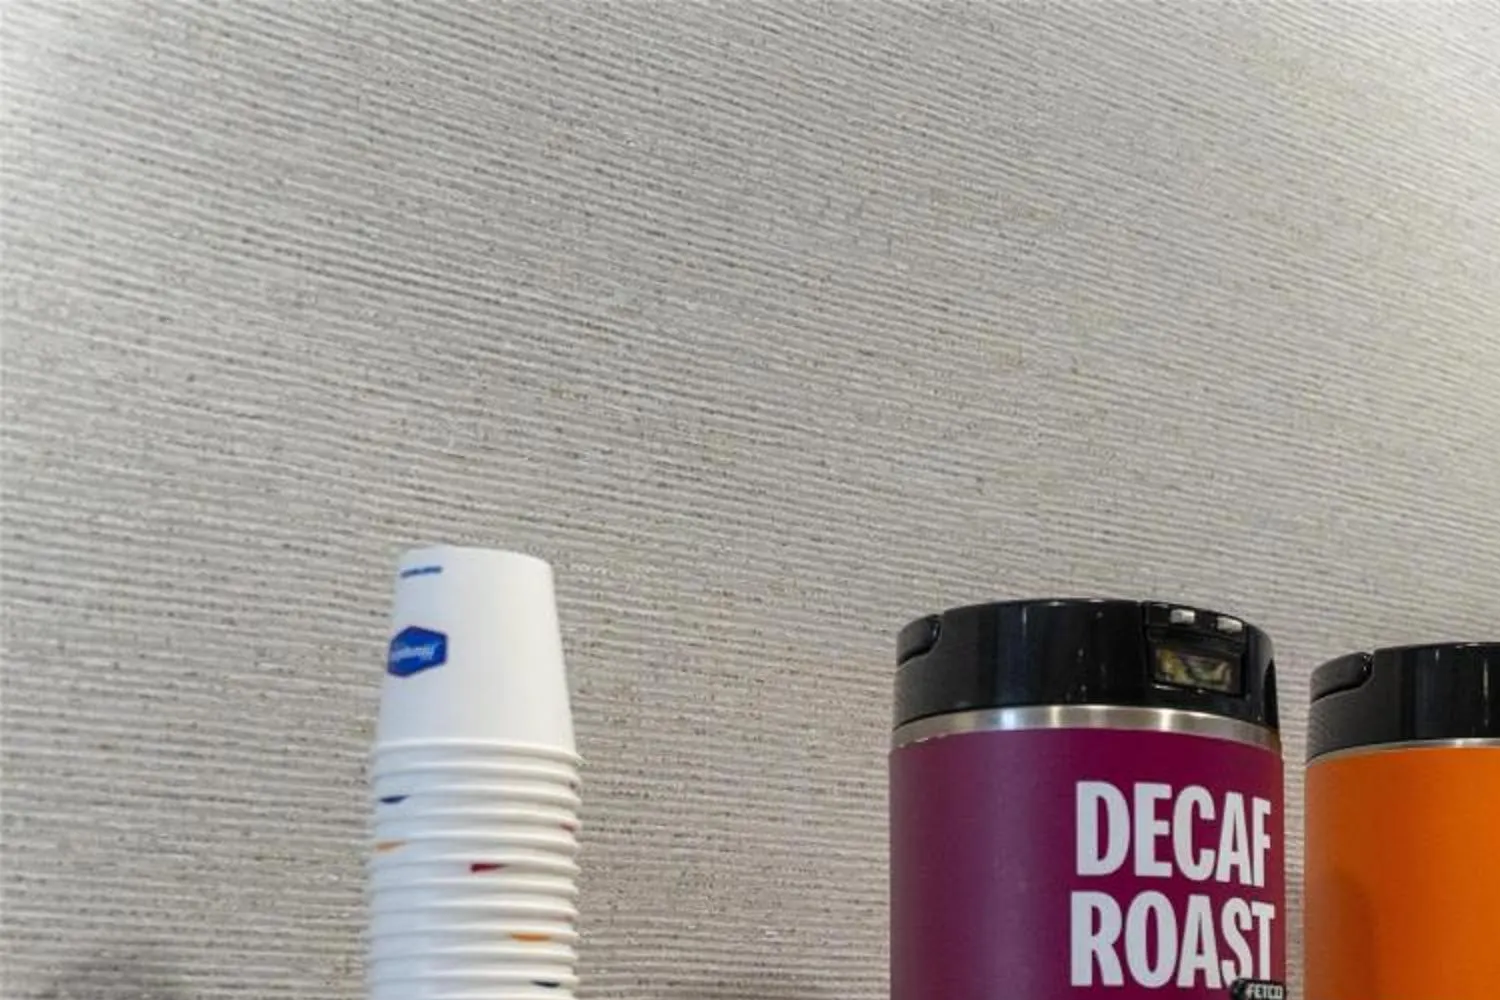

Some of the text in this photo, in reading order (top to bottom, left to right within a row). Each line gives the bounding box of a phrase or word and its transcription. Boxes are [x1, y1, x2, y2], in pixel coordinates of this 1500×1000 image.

[1076, 781, 1271, 887] DECAF
[1070, 890, 1276, 988] ROAST
[1246, 983, 1283, 1000] FETCO
